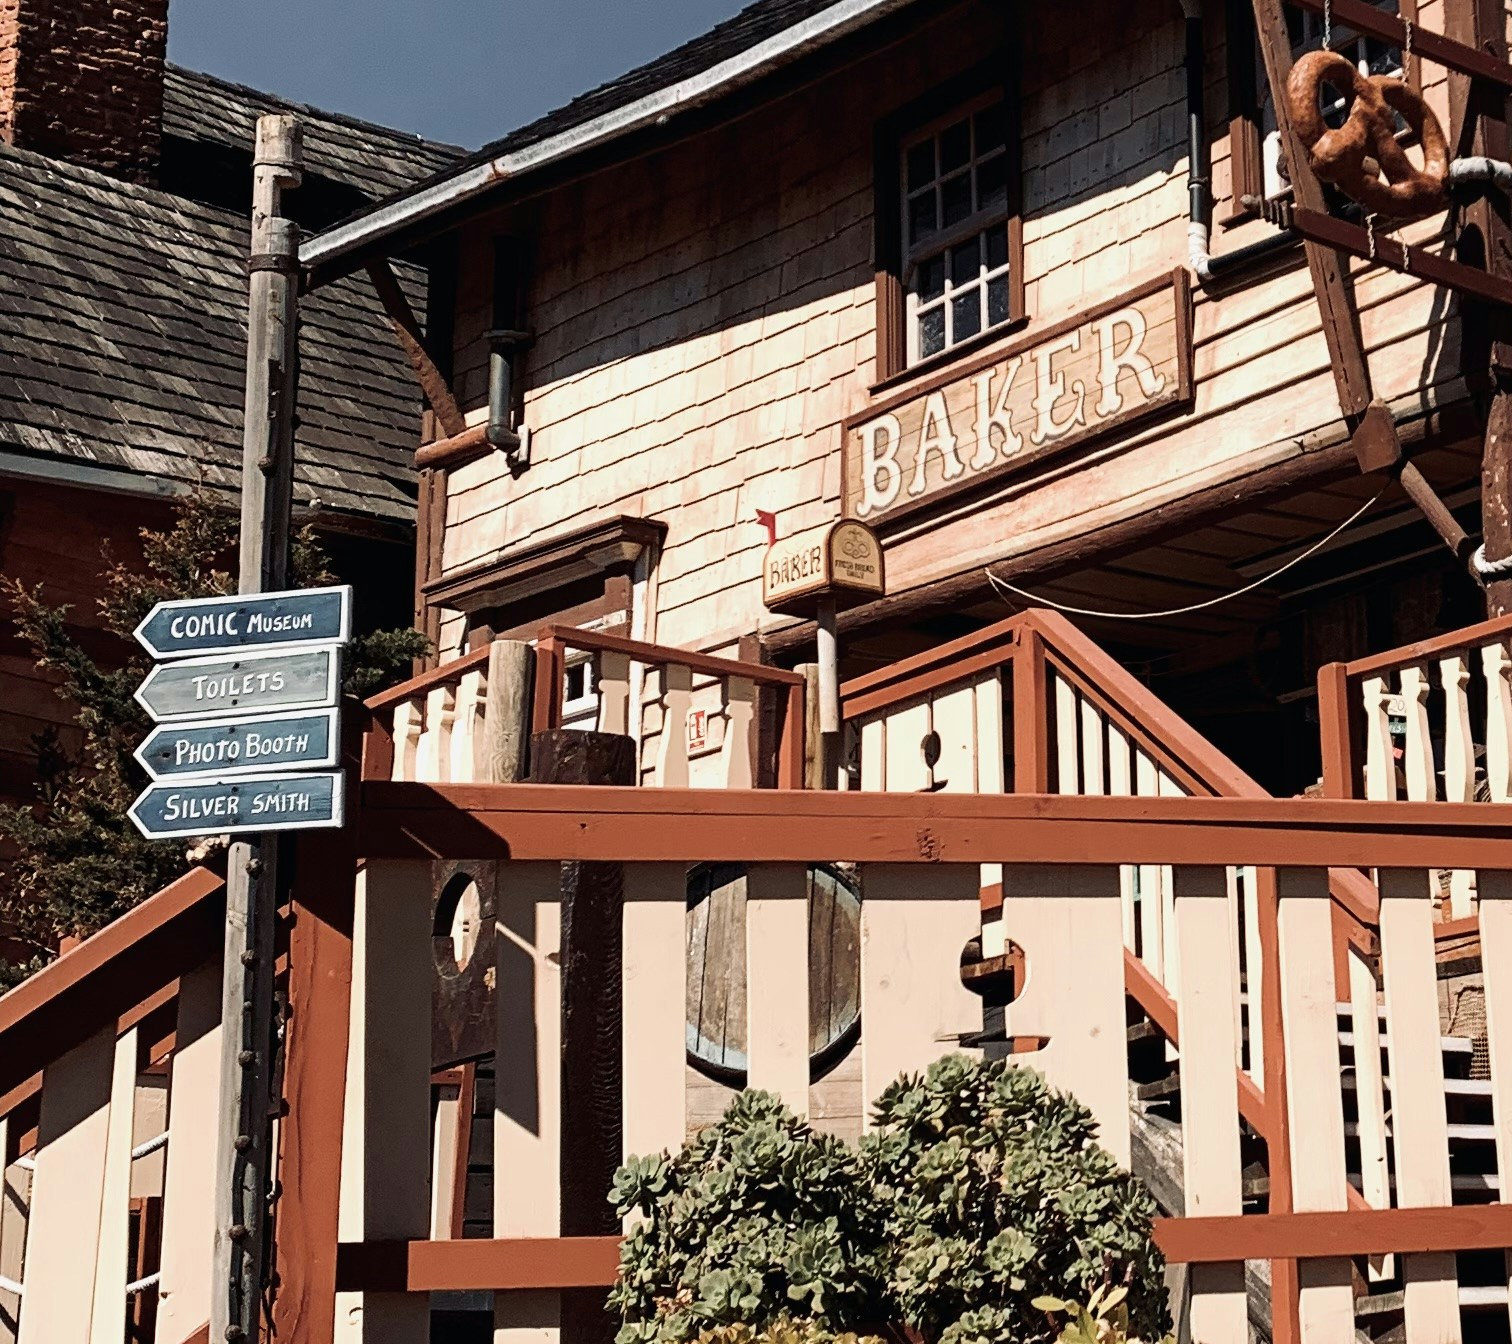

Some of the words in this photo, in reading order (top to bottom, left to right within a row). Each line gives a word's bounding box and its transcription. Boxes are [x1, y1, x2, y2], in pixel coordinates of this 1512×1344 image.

[856, 306, 1166, 518] BAKER
[770, 545, 821, 589] BAKER
[855, 562, 875, 574] BREAD
[170, 612, 238, 639] COMIC
[192, 671, 284, 701] TOILETS
[175, 739, 240, 766] PHOTO
[245, 733, 308, 759] BOOTH
[164, 794, 238, 820] SILVER
[251, 792, 309, 814] SMITH
